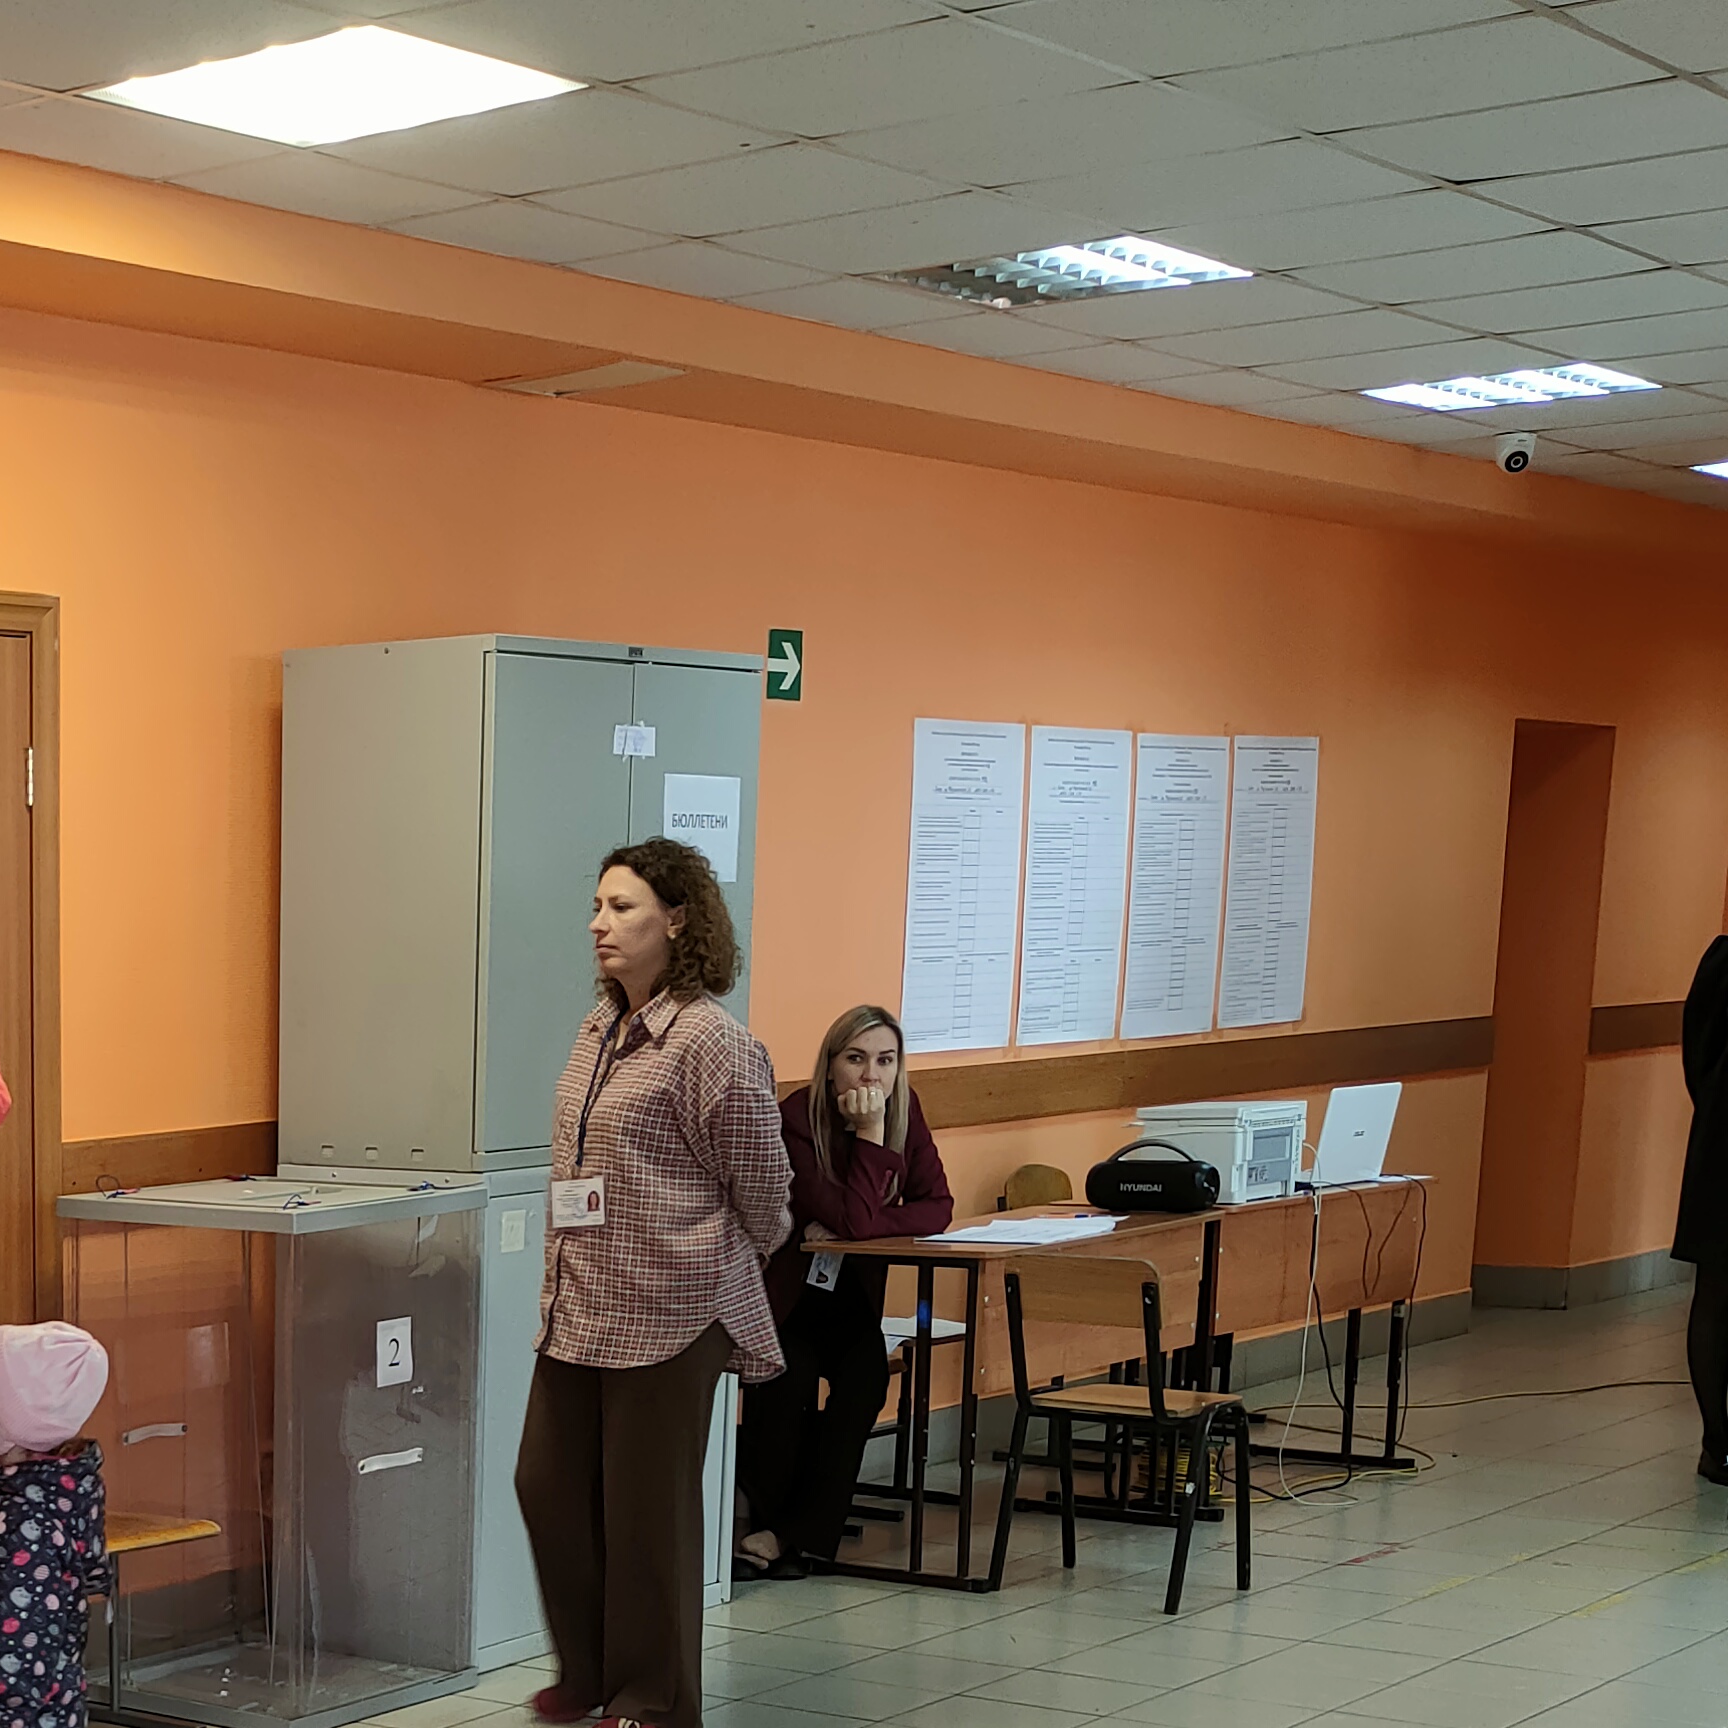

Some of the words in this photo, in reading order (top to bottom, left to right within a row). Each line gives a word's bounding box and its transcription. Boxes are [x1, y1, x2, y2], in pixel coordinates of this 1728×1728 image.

[672, 813, 728, 829] БЮЛЛЕТЕНИ
[1120, 1183, 1162, 1192] HYUNDAI
[387, 1337, 401, 1367] 2
